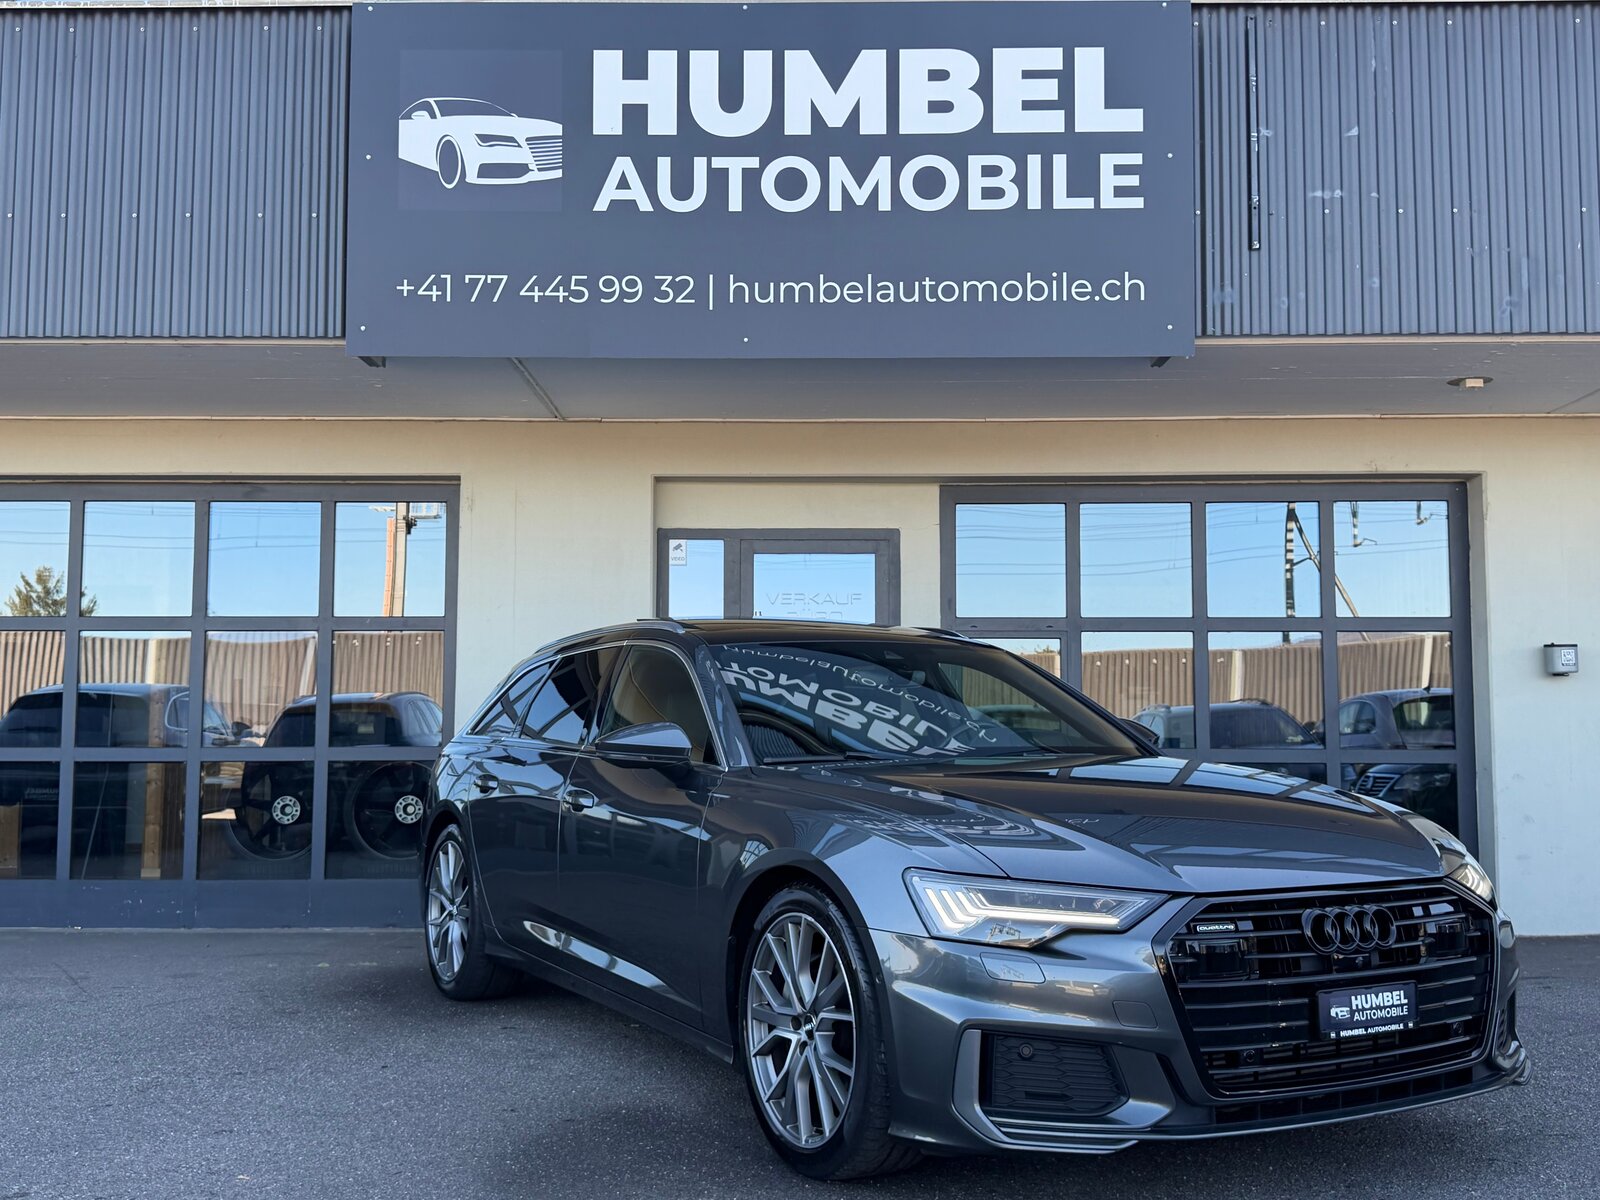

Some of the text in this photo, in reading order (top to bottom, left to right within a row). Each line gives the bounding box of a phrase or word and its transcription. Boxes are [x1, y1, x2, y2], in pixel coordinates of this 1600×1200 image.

[592, 46, 1144, 138] HUMBEL
[592, 152, 1145, 213] AUTOMOBILE
[396, 274, 452, 303] +41
[464, 274, 509, 303] 77
[519, 274, 589, 304] 445
[598, 275, 643, 304] 99
[653, 275, 696, 304] 32
[729, 271, 1145, 304] humbelautomobile.ch
[766, 592, 862, 605] VERKAUF
[1351, 990, 1408, 1010] HUMBEL
[1353, 1006, 1409, 1022] AUTOMOBILE
[1340, 1028, 1366, 1038] HUMBEL
[1367, 1023, 1405, 1033] AUTOMOBILE
